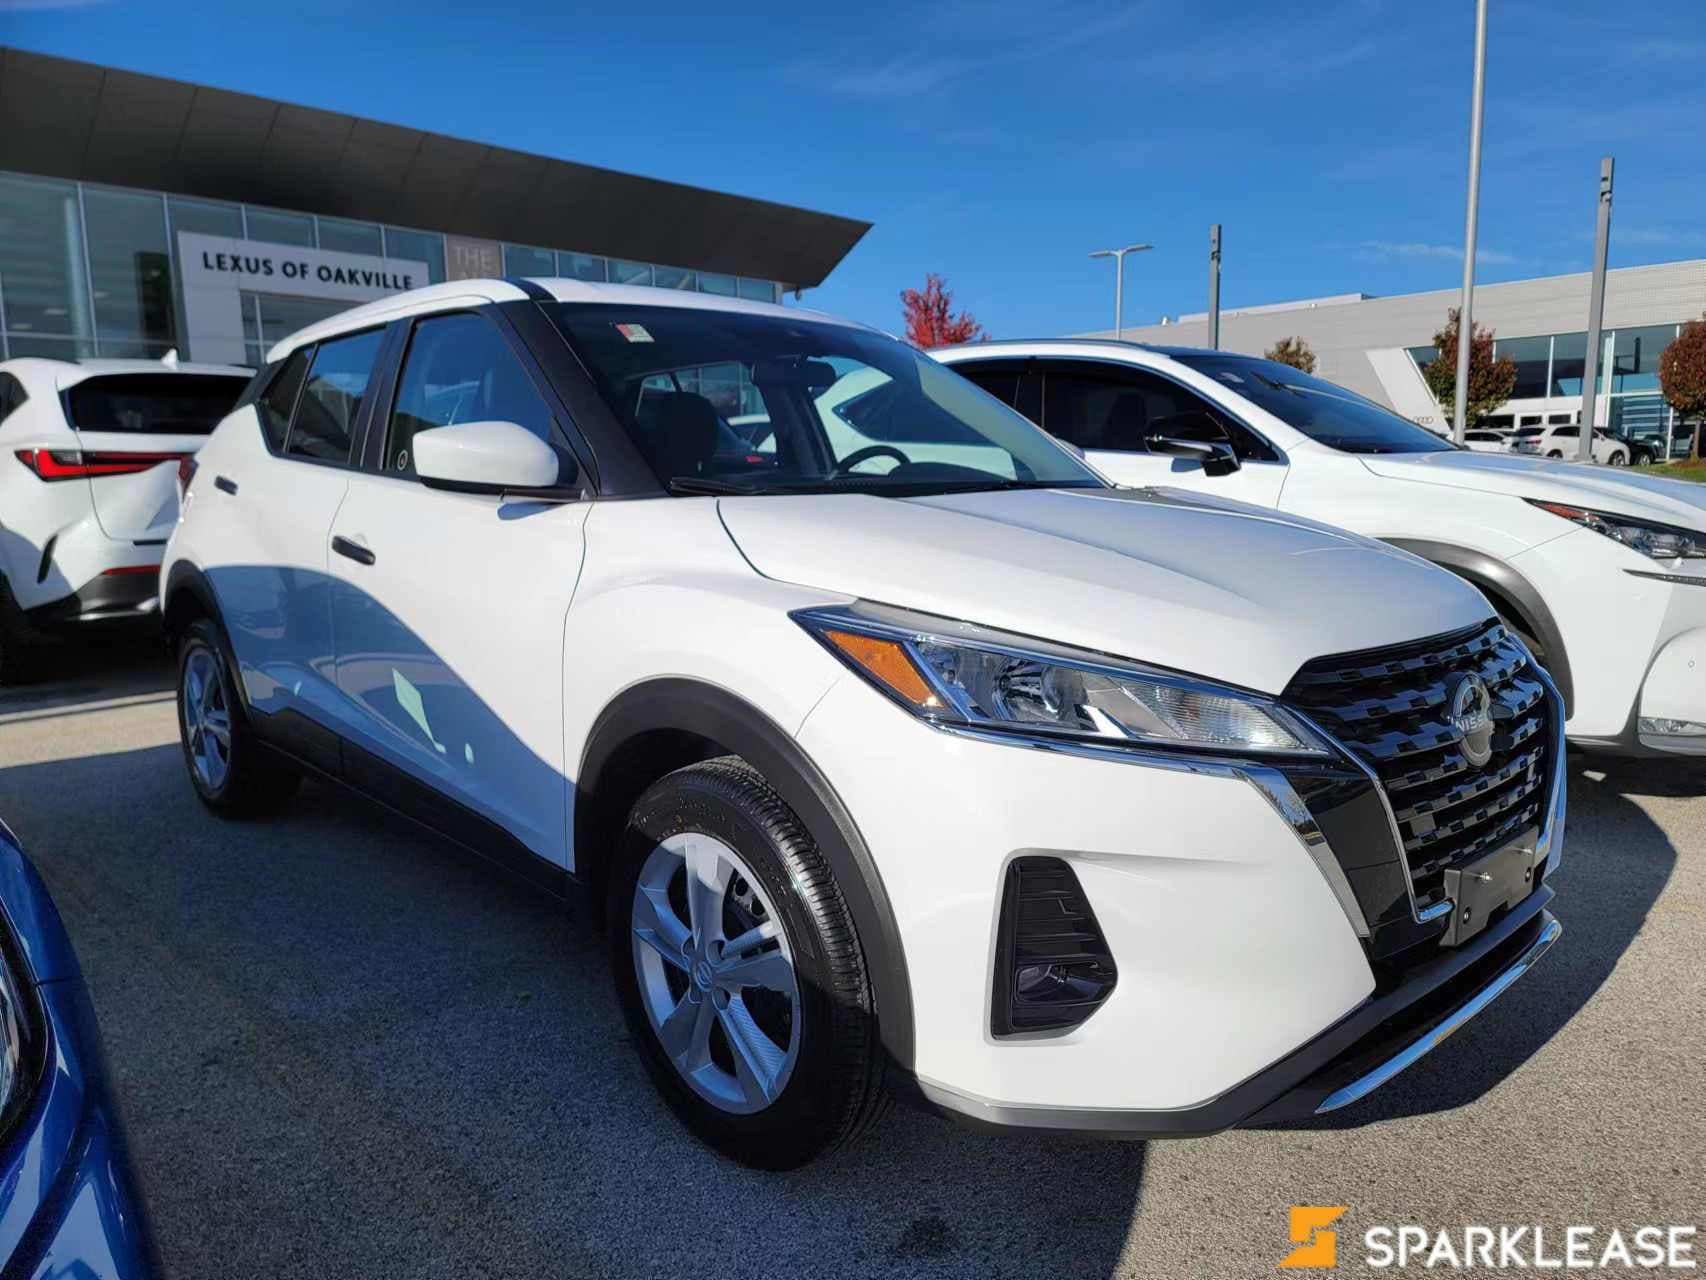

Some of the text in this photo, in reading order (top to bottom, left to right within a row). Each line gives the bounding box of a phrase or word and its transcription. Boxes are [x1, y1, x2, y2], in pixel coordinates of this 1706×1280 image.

[203, 251, 412, 290] LEXUS OF OAKVILLE
[454, 246, 491, 271] THE
[1455, 713, 1492, 733] NISS
